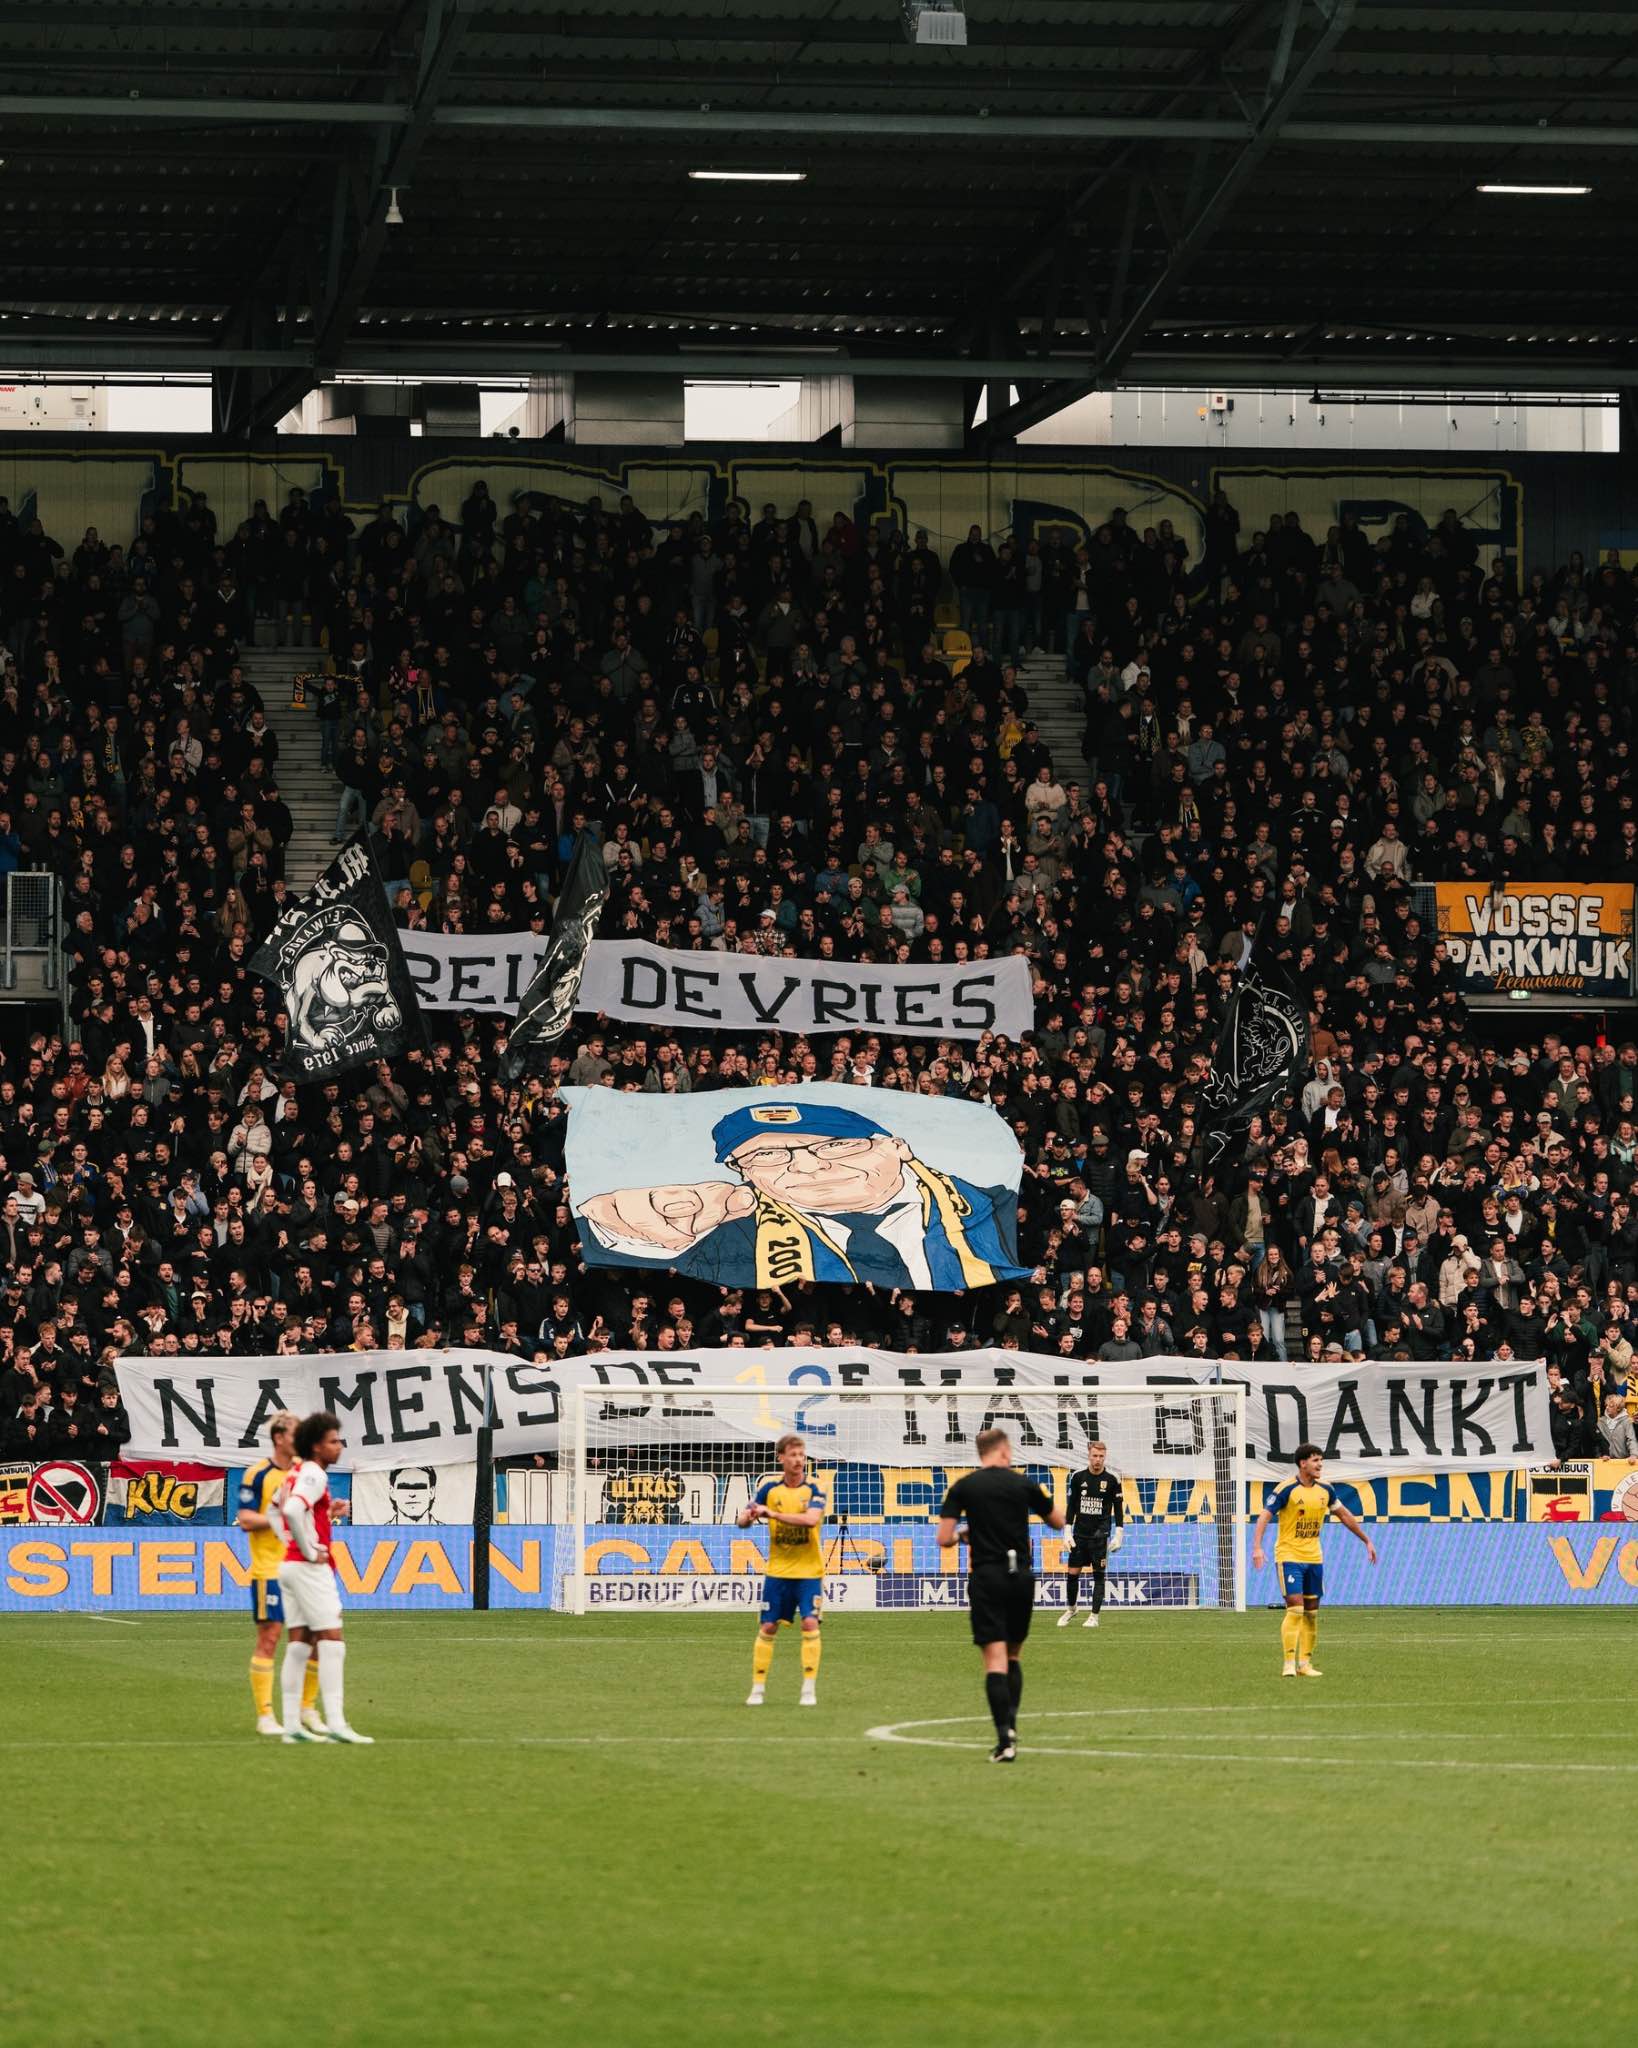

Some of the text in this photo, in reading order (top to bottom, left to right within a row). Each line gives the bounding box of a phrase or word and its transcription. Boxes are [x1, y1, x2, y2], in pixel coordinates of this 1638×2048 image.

[1465, 894, 1604, 937] VOSSE
[1445, 936, 1632, 980] PARKWIJK
[402, 950, 997, 1030] REI DE VRIES
[154, 1364, 562, 1448] NAMENS
[590, 1360, 715, 1421] DE
[898, 1367, 1100, 1450] MAN
[126, 1472, 199, 1519] KVC
[611, 1476, 677, 1498] ULTRAS
[330, 1541, 541, 1594] VAN
[590, 1582, 685, 1602] BEDRIJF
